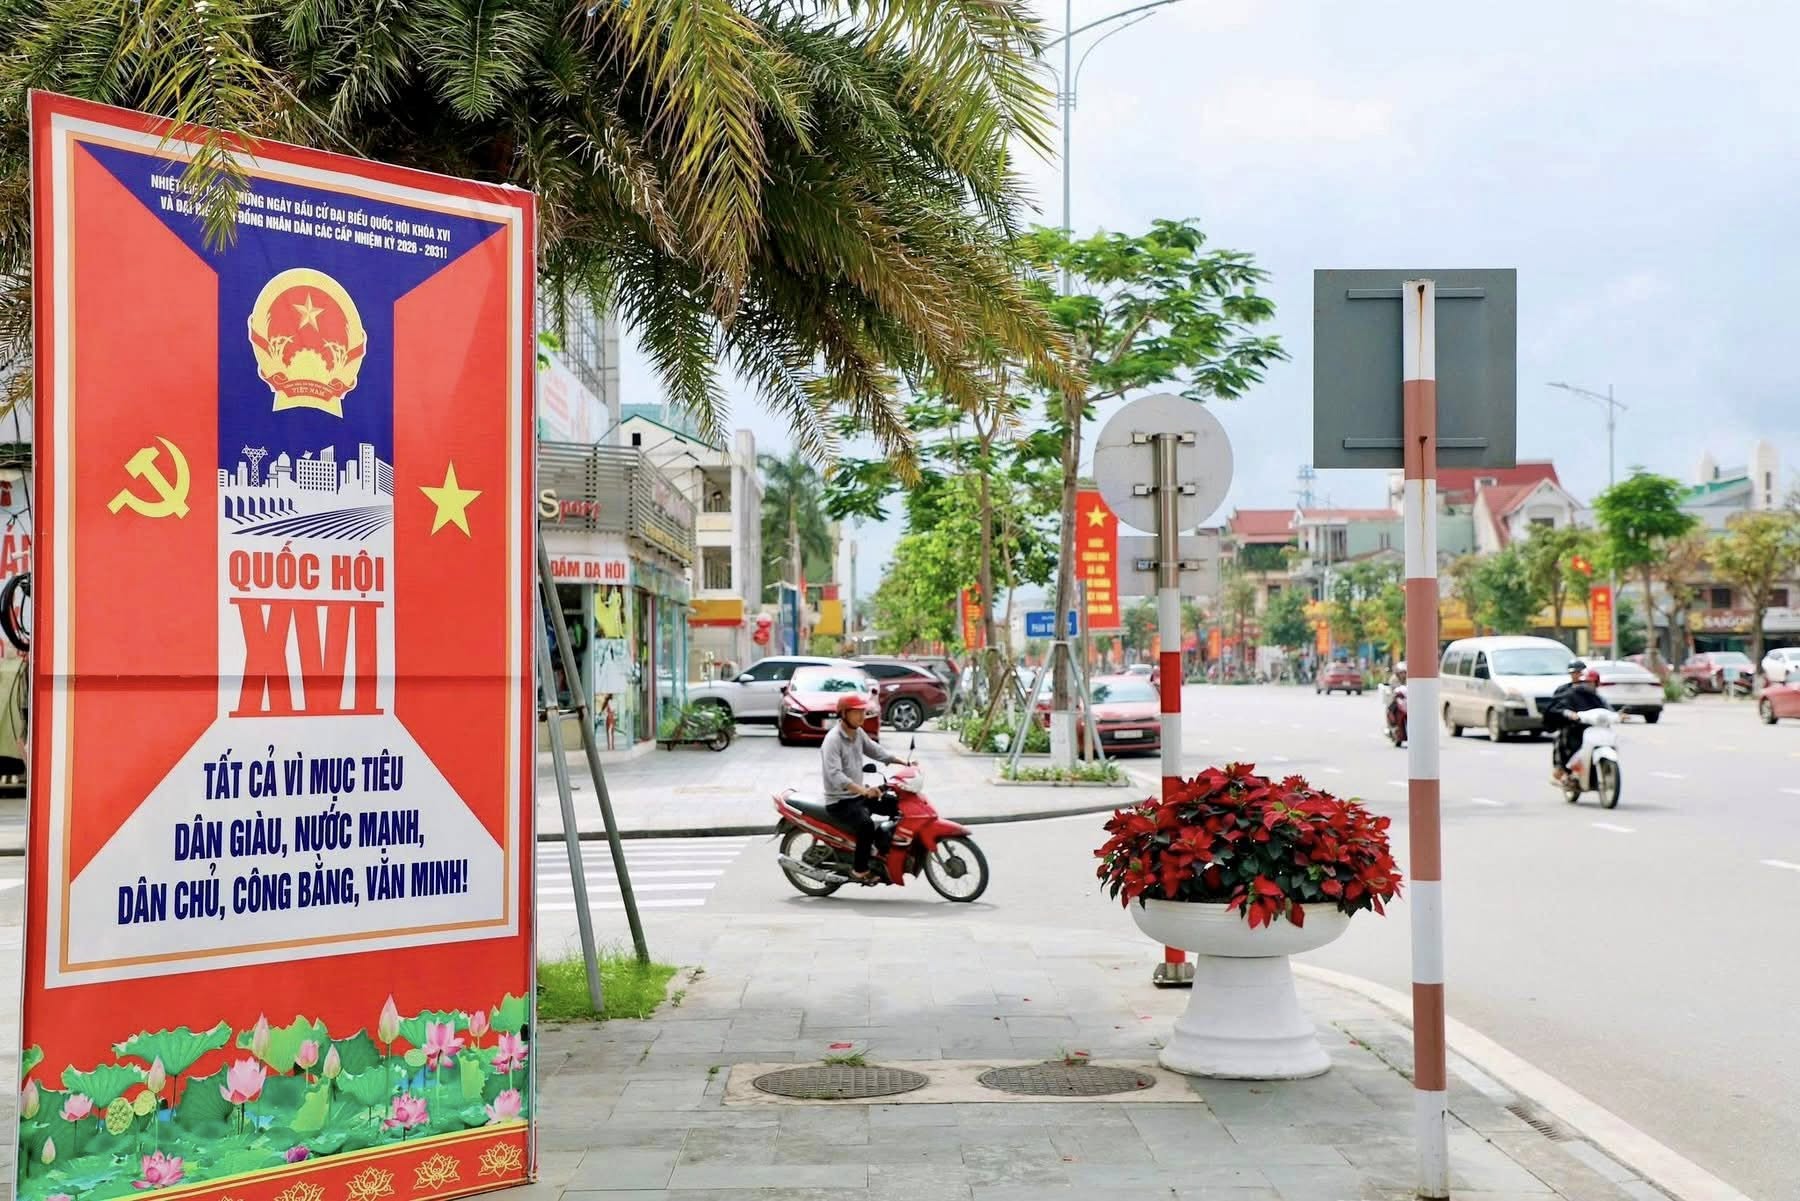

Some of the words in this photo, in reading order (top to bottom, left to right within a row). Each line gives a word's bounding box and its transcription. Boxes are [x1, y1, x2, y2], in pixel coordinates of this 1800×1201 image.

[151, 174, 181, 194] NHIỆT
[266, 197, 292, 213] NGÀY
[315, 201, 329, 220] CỬ
[330, 208, 345, 225] ĐẠI
[347, 208, 368, 227] BIỂU
[370, 214, 394, 232] QUỐC
[395, 219, 410, 236] HỘI
[412, 223, 435, 240] KHÓA
[436, 228, 451, 242] XVI
[160, 194, 174, 211] VÀ
[176, 199, 193, 217] ĐẠI
[238, 208, 264, 228] ĐỒNG
[266, 215, 292, 232] NHÂN
[293, 219, 313, 236] DÂN
[315, 223, 333, 239] CÁC
[335, 225, 353, 242] CẤP
[354, 231, 382, 249] NHIỆM
[384, 235, 395, 250] KỲ
[397, 240, 418, 254] 2026
[425, 244, 448, 259] 2031!
[229, 541, 320, 592] QUỐC
[331, 549, 385, 598] HỘI
[605, 560, 625, 582] HỘI
[229, 597, 385, 718] XVI
[204, 748, 242, 800] TẤT
[250, 745, 277, 798] CẢ
[284, 751, 303, 796] VÌ
[310, 756, 355, 802] MỤC
[361, 749, 404, 792] TIÊU
[174, 814, 222, 861] DÂN
[230, 811, 287, 858] GIÀU,
[294, 803, 351, 852] NƯỚC
[359, 809, 424, 854] MẠNH,
[118, 876, 167, 925] DÂN
[174, 863, 226, 921] CHỦ,
[233, 868, 291, 915] CÔNG
[298, 853, 359, 907] BẰNG,
[366, 857, 405, 902] VĂN
[411, 858, 468, 896] MINH!
